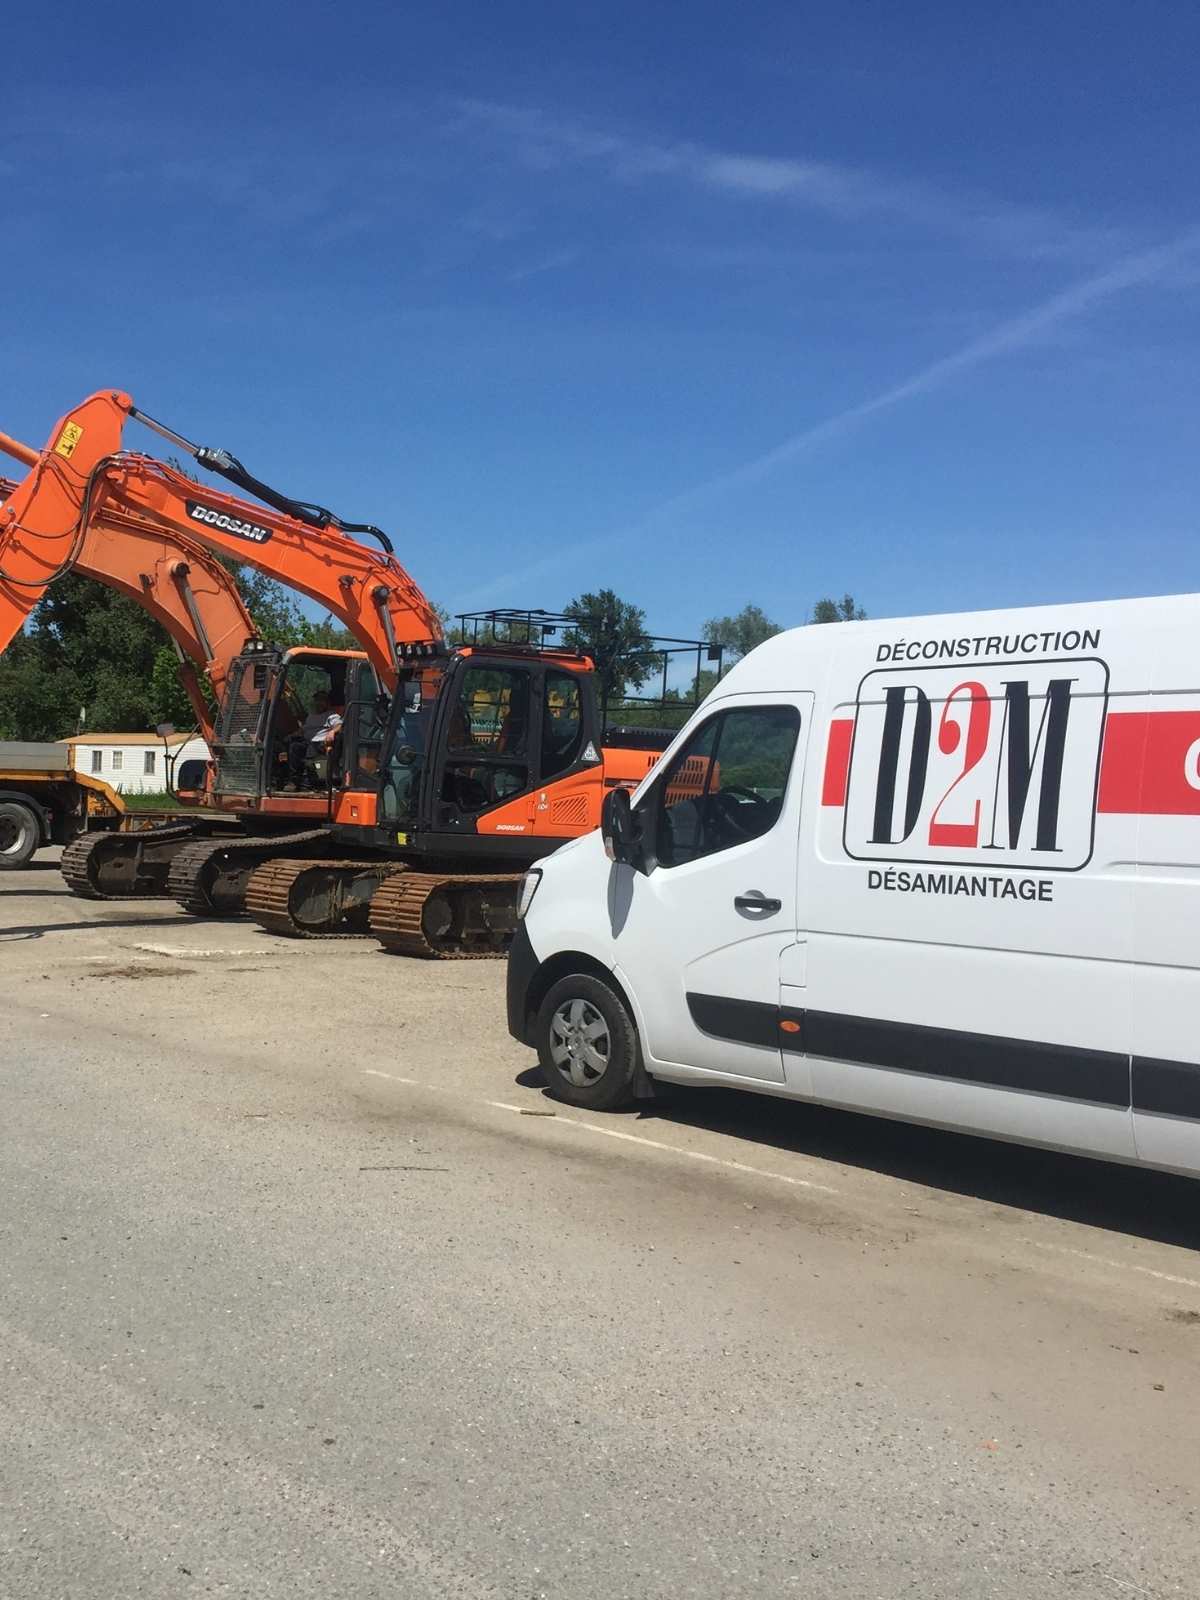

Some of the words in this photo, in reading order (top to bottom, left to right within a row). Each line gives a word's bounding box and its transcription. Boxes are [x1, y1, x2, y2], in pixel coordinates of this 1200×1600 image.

[191, 506, 266, 541] DOOSAN
[876, 629, 1101, 662] DÉCONSTRUCTION
[866, 678, 1079, 851] D2M
[867, 866, 1053, 901] DÉSAMIANTAGE
